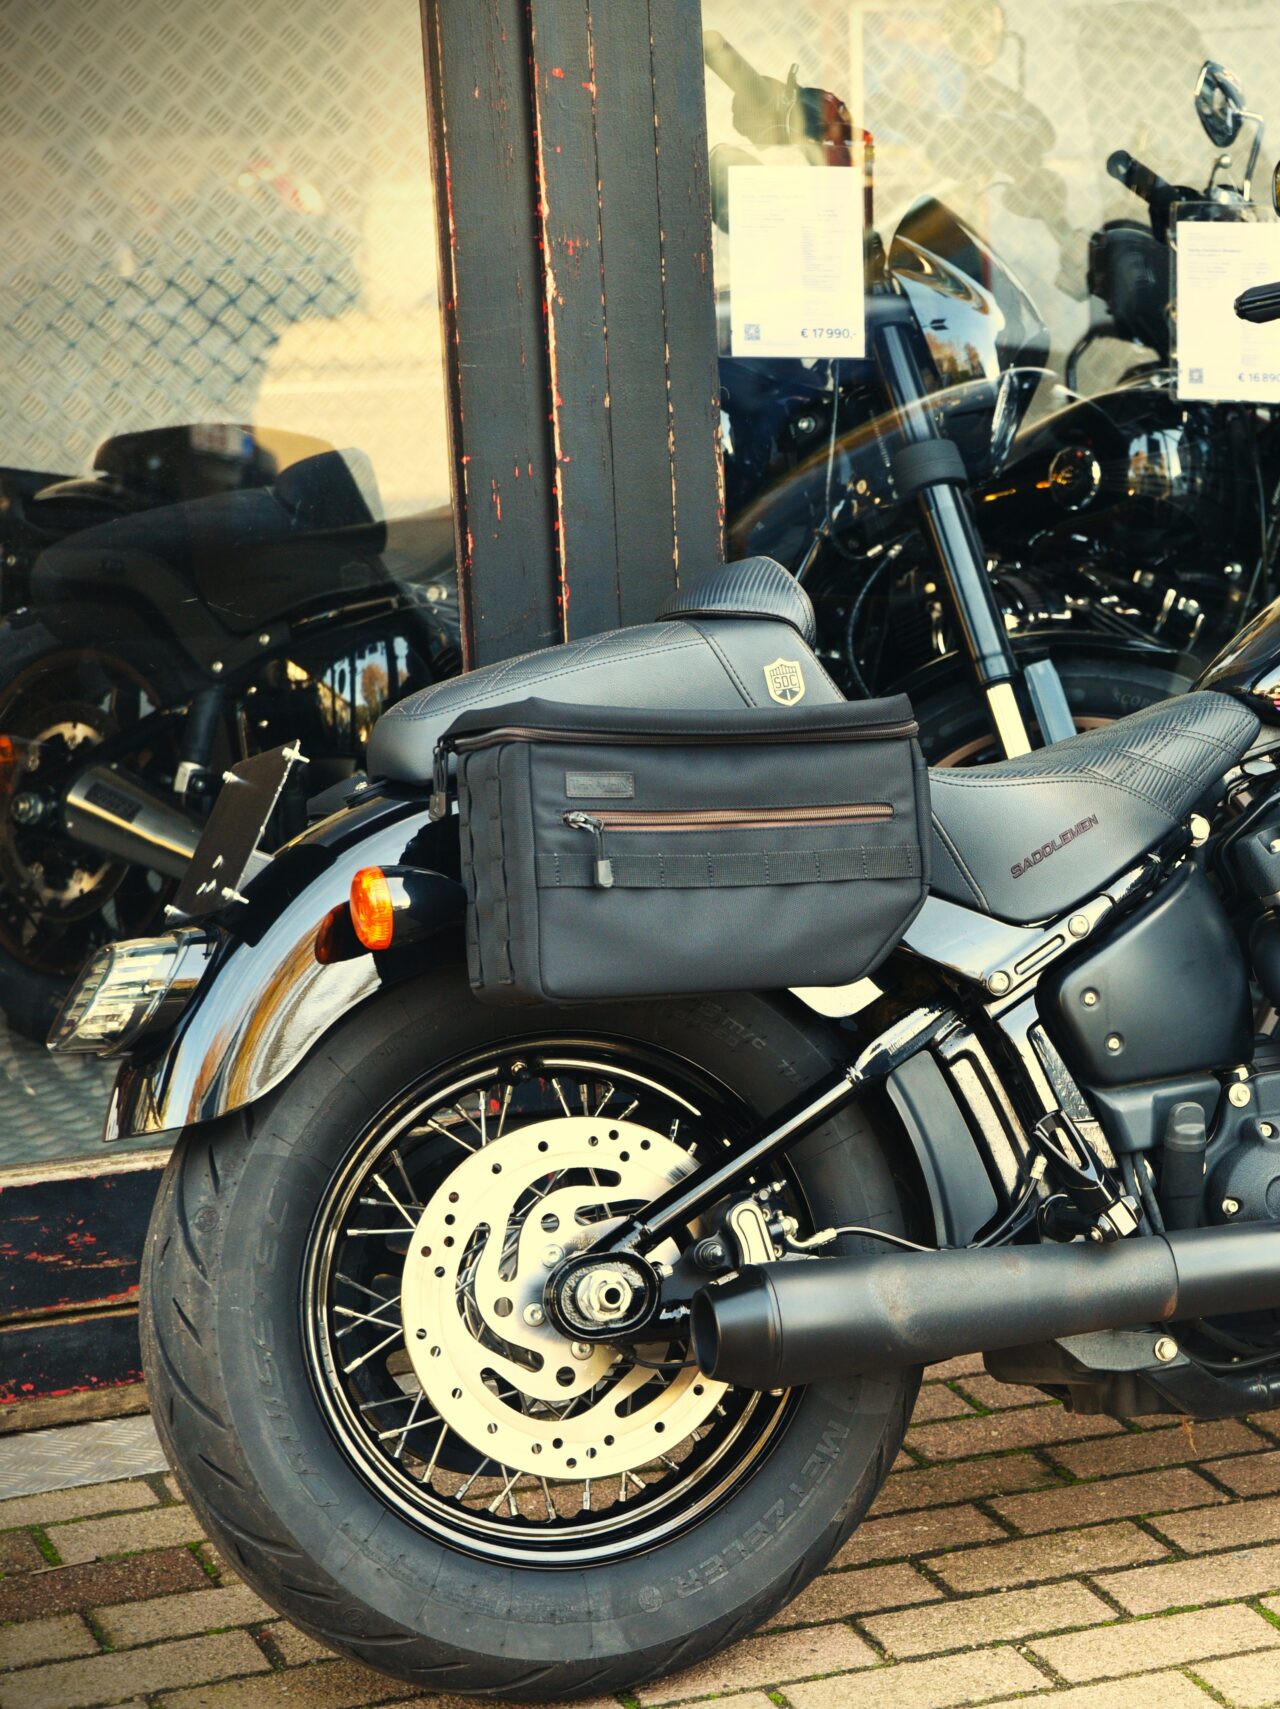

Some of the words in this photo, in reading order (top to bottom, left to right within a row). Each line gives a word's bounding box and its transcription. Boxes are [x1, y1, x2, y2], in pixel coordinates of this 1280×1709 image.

[773, 674, 798, 690] SDC
[1010, 814, 1099, 879] SADDLEMEN
[670, 1419, 850, 1599] METZELER
